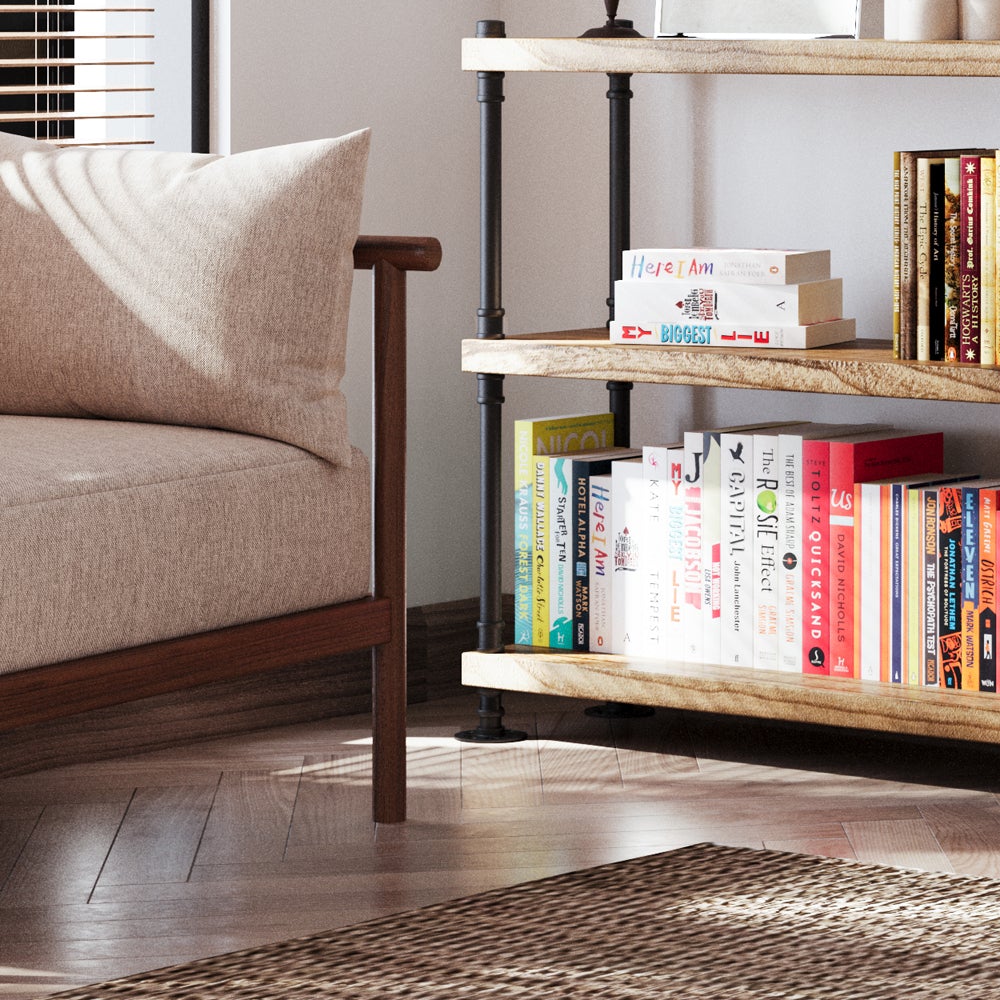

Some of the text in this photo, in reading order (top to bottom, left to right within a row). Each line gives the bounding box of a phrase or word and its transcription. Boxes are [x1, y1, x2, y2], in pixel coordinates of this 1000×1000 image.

[631, 255, 714, 279] Here I Am
[918, 202, 927, 280] The Epic Cycle
[932, 237, 939, 246] of
[622, 326, 652, 339] MY
[661, 324, 712, 344] BIGGEST
[721, 331, 770, 344] LIE
[962, 275, 970, 345] HOGWARTS
[971, 275, 979, 345] A HISTORY
[577, 477, 587, 558] HOTEL ALPHA
[761, 449, 775, 592] The Effect
[811, 469, 821, 523] TOLTZ
[926, 496, 936, 514] JON
[519, 431, 528, 620] NICOLE KRAUSS FOREST DARK
[926, 514, 936, 555] RONSON
[965, 493, 975, 599] ELEVEN
[809, 530, 822, 639] QUICKSAND
[837, 534, 845, 642] DAVID NICHOLLS
[926, 563, 936, 579] THE
[944, 589, 949, 597] OF
[981, 559, 995, 604] OSTRICH
[926, 581, 936, 633] PSYCHOPATH
[926, 635, 936, 655] TEST
[966, 610, 974, 668] MARK WATSON
